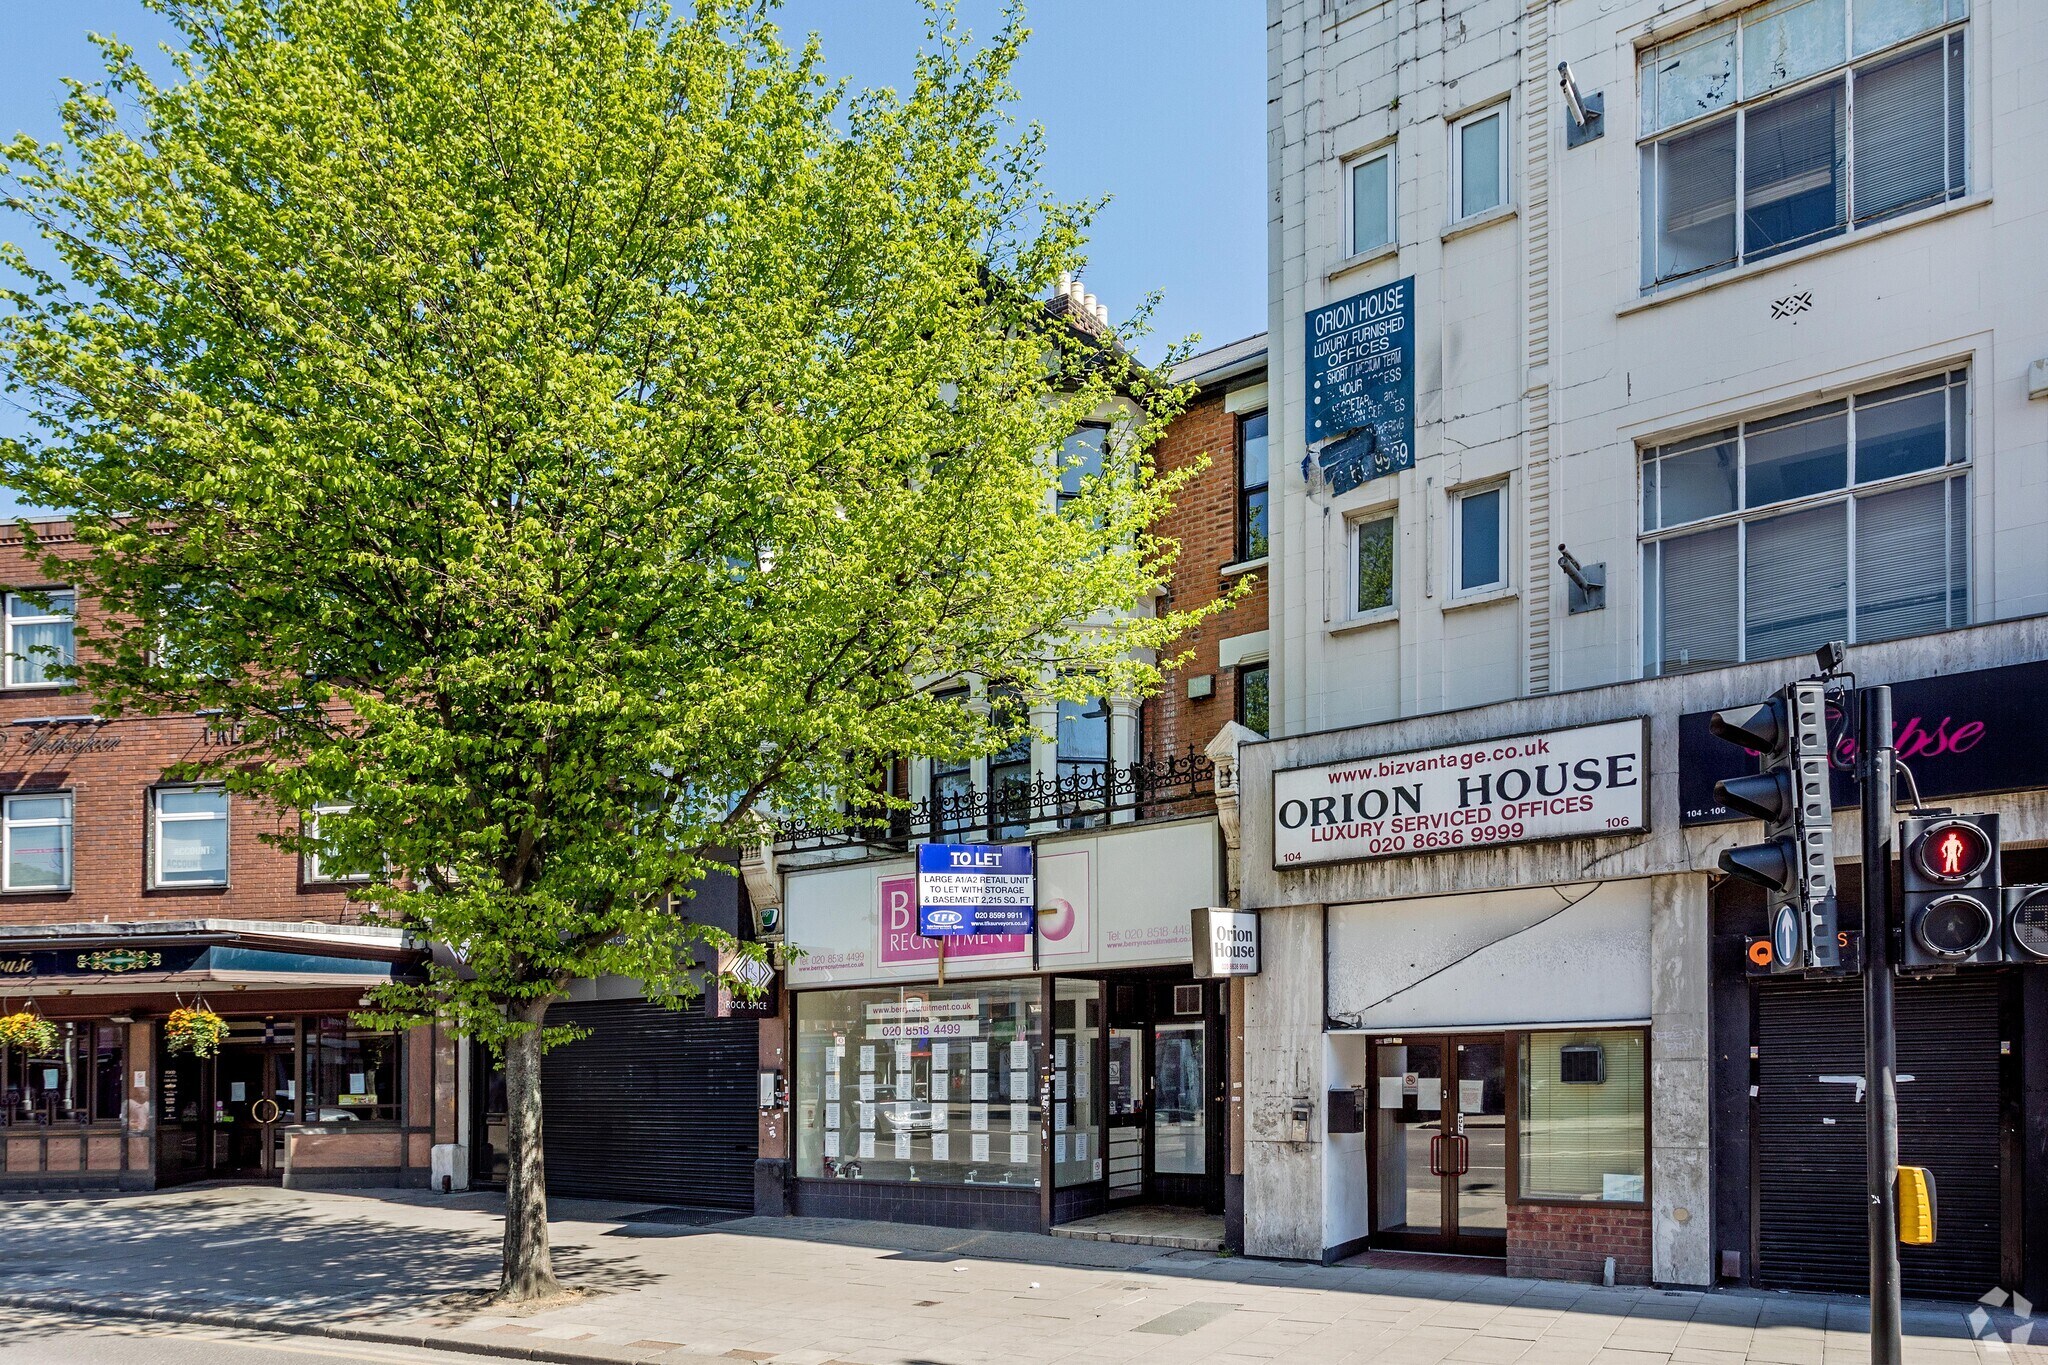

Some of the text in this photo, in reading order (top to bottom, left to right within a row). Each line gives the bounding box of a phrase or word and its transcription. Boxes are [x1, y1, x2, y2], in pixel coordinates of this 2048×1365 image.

[1315, 285, 1404, 337] ORION HOUSE
[1314, 316, 1405, 358] LUXURY FURNISHED
[1328, 337, 1390, 367] OFFICES
[1327, 366, 1349, 385] SHORT
[1382, 350, 1402, 367] TERM
[1328, 739, 1550, 784] www.bizvantage.co.uk
[1279, 753, 1638, 829] ORION HOUSE
[1710, 806, 1726, 815] 106
[1311, 795, 1594, 843] LUXURY SERVICED OFFICES
[1605, 816, 1629, 828] 106
[1369, 822, 1524, 854] 020 8636 9999
[950, 852, 1002, 866] TO LET
[1283, 852, 1302, 863] 104
[924, 875, 1030, 884] LARGE A1/A2 RETAIL UNIT
[930, 885, 1024, 894] TO LET WITH STORAGE
[924, 895, 1030, 905] & BASEMENT 2,215 SQ. FT
[933, 913, 956, 922] TFK
[970, 920, 1028, 928] www.tfksurveyors.co.uk
[1124, 928, 1143, 939] 020
[1146, 926, 1169, 938] 8518
[1172, 924, 1191, 935] 449
[1217, 925, 1253, 942] Orion
[1107, 936, 1191, 949] www.berryrecruitment.co.
[1215, 942, 1255, 958] House
[811, 955, 826, 965] 020
[846, 951, 865, 962] 4499
[726, 1001, 767, 1010] ROCK SPICE
[882, 1023, 961, 1036] 020 8518 4499
